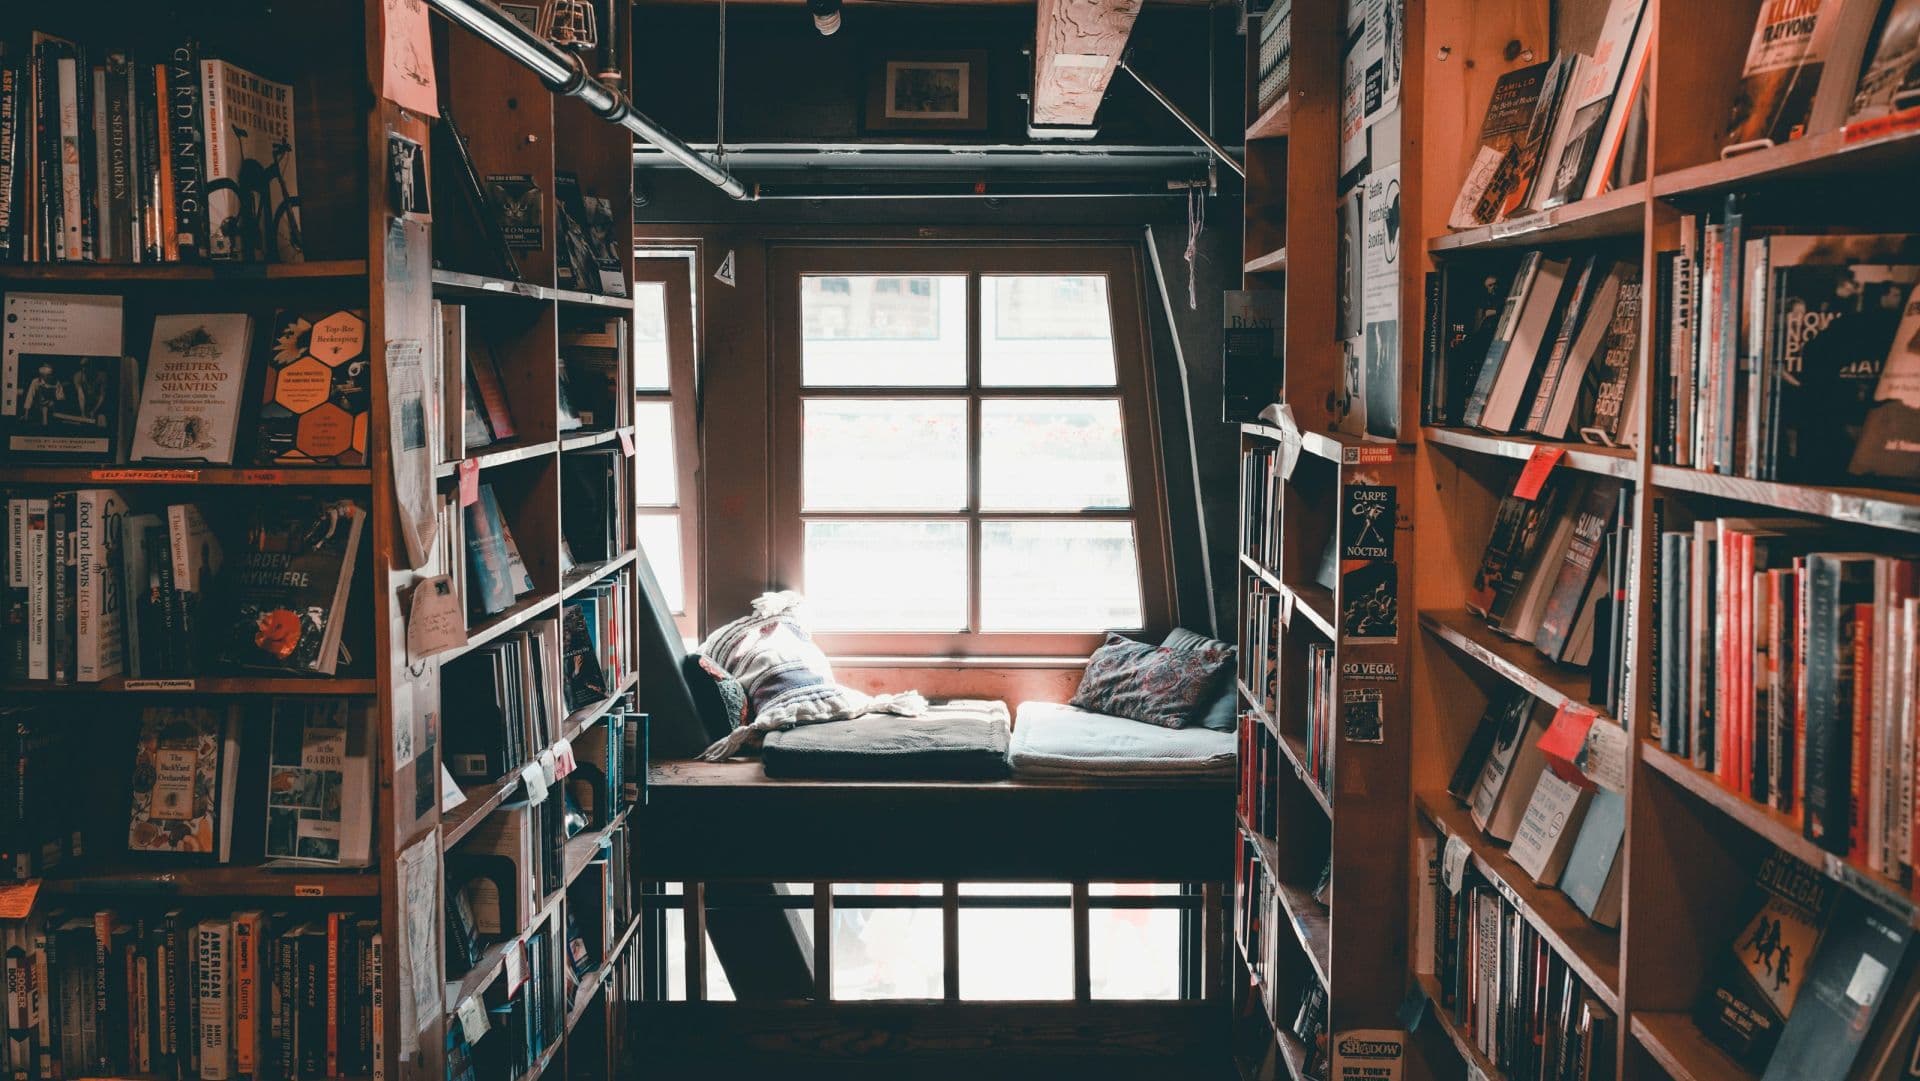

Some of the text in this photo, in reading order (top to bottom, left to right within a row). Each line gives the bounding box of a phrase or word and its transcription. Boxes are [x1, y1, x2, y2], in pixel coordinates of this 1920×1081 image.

[2, 70, 13, 92] ASK
[2, 96, 12, 119] THE
[1, 121, 11, 162] FAMILY
[115, 114, 125, 147] SEED
[174, 47, 198, 213] GARDENING
[116, 148, 127, 200] GARDEN
[1680, 258, 1690, 329] DEFIANT
[161, 382, 218, 391] SHANTIES
[203, 372, 228, 381] AND
[1353, 491, 1388, 501] CARPE
[80, 501, 94, 528] food
[80, 532, 93, 551] not
[1347, 547, 1388, 557] NOCTEM
[80, 553, 93, 588] lawns
[80, 610, 90, 636] Flores
[1343, 663, 1359, 674] GO
[200, 931, 210, 998] PASTIMES
[210, 932, 222, 999] AMERICAN
[8, 968, 17, 993] BOOK
[18, 971, 27, 1008] SOCCER
[308, 963, 316, 1008] BICYCLE
[239, 978, 251, 1020] Running
